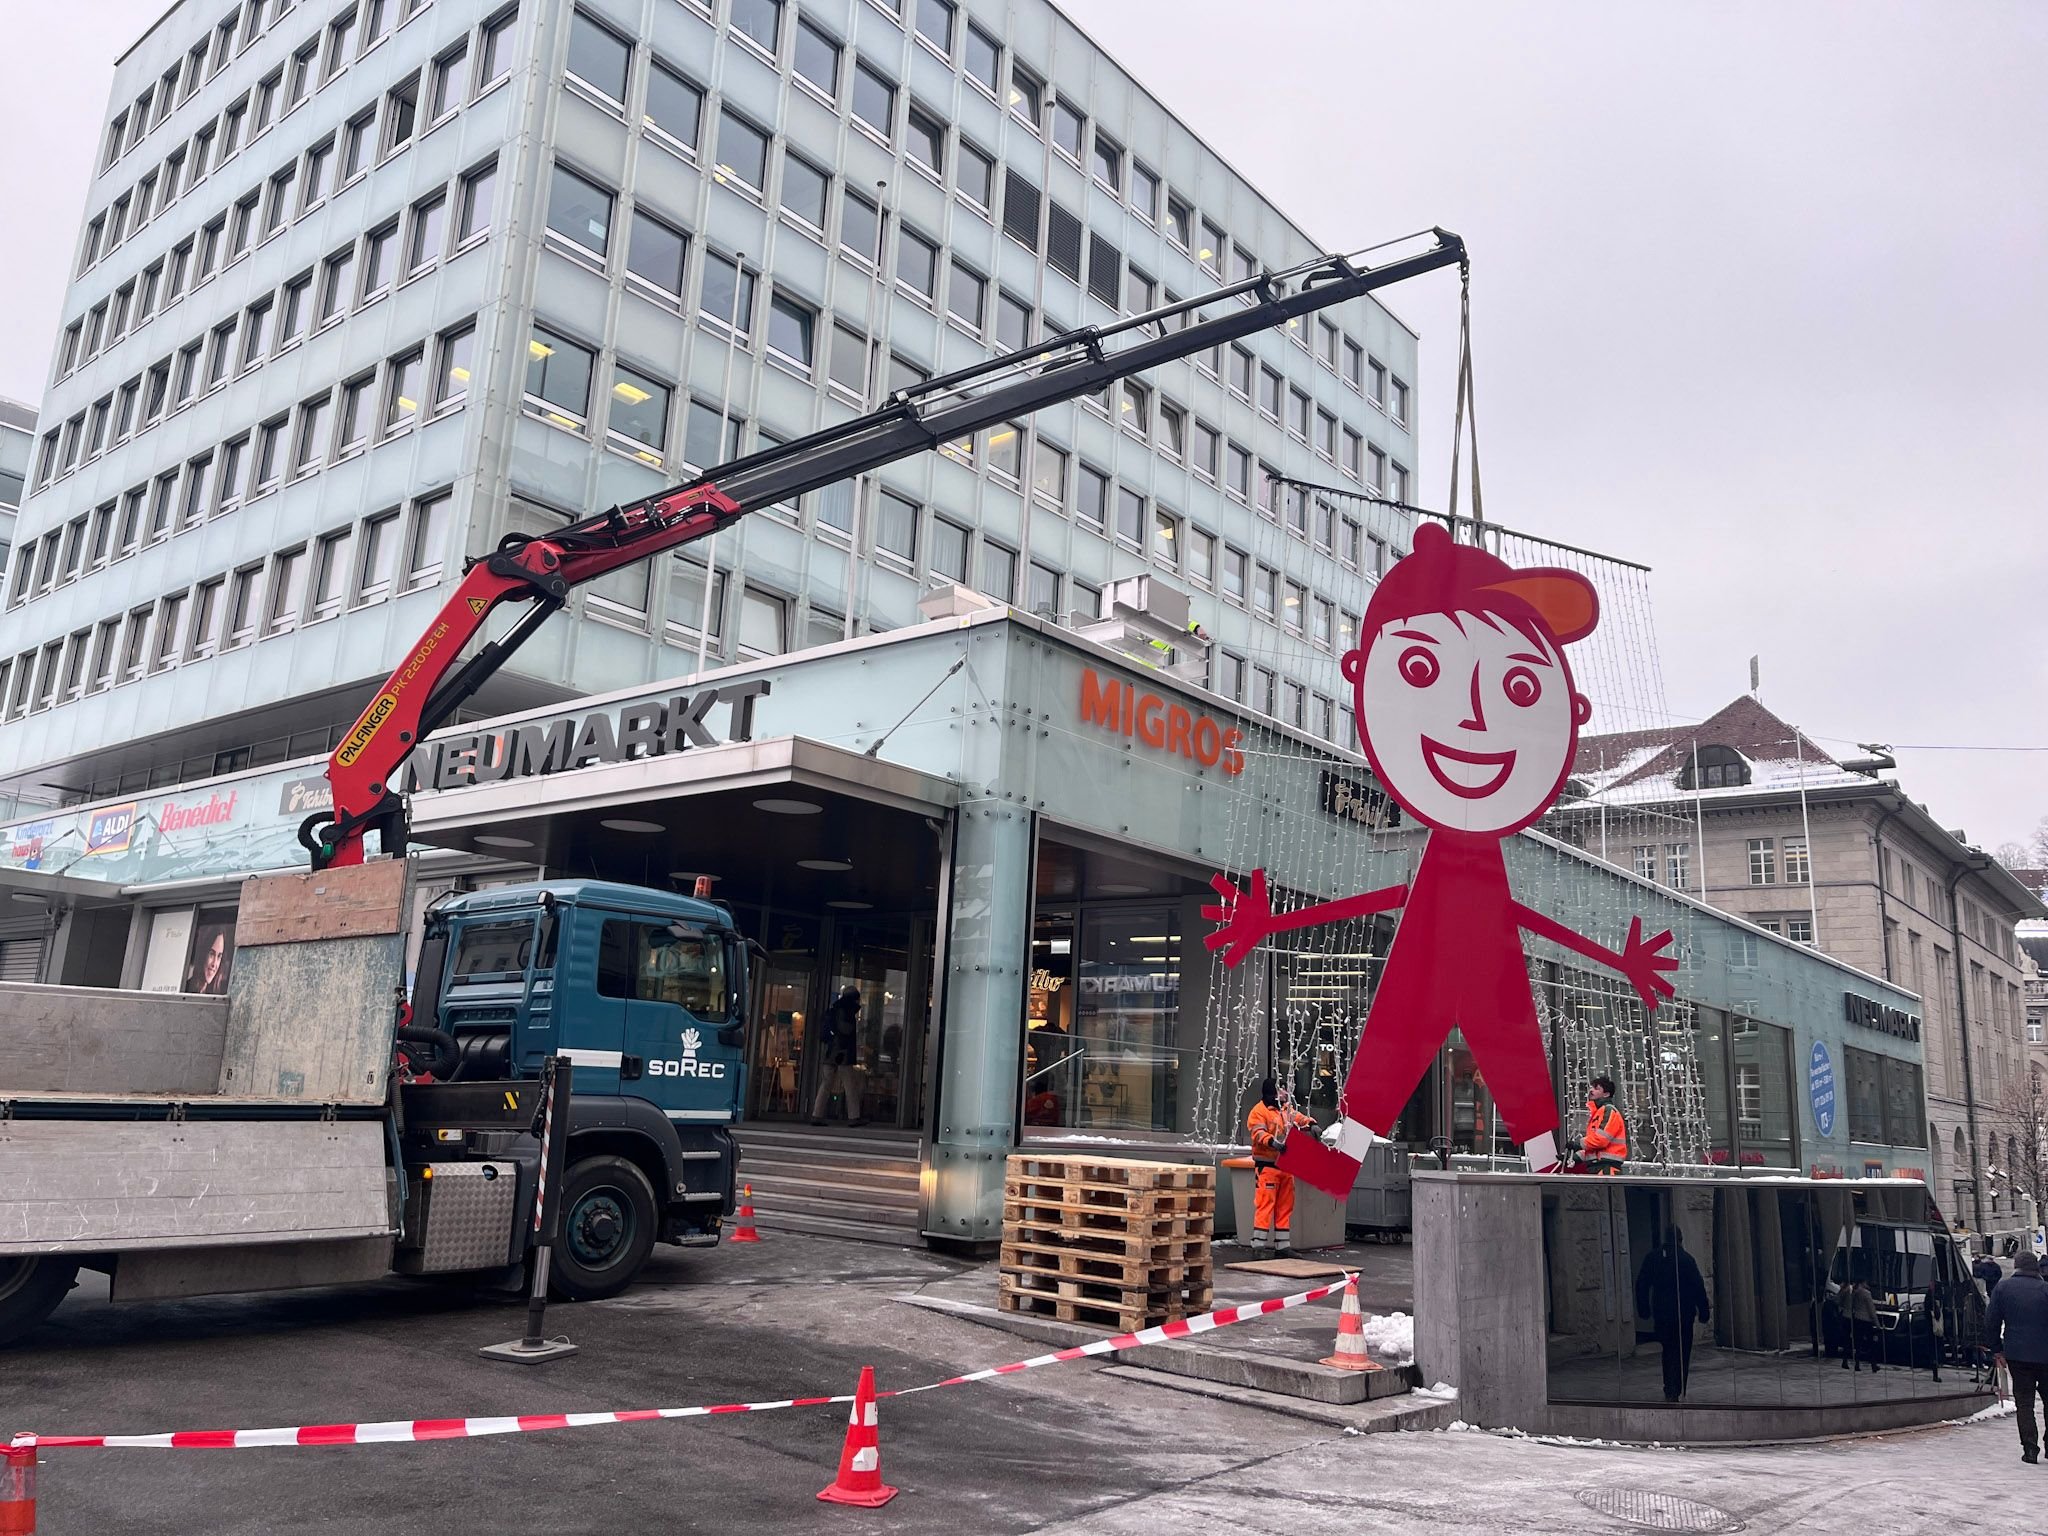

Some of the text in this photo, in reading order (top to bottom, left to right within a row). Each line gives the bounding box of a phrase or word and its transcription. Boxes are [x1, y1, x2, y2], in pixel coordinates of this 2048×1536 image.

[391, 677, 409, 697] PK
[340, 697, 394, 763] PALFINGER
[401, 679, 771, 794] NEUMARKT
[1081, 668, 1245, 776] MIGROS
[158, 790, 238, 833] Bénédict
[302, 787, 334, 809] Tchib
[103, 814, 129, 837] ALDI
[1845, 989, 1921, 1043] NEUMARKT
